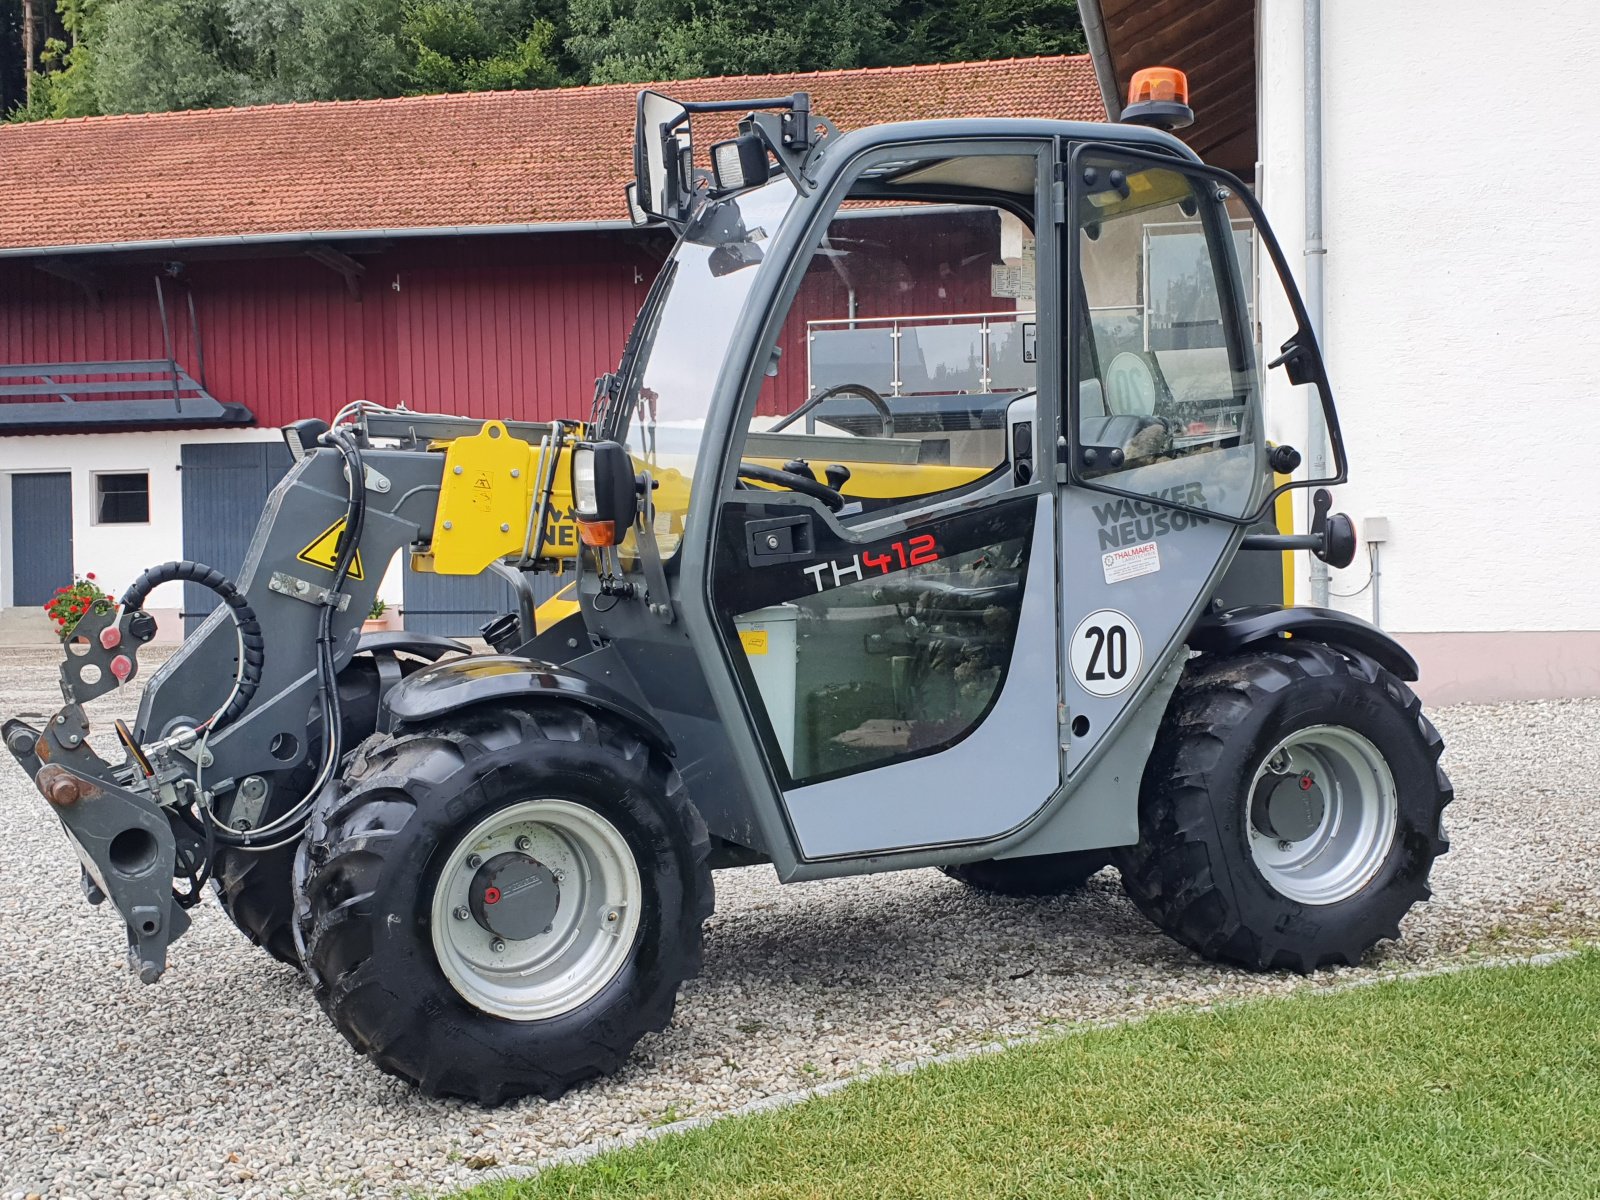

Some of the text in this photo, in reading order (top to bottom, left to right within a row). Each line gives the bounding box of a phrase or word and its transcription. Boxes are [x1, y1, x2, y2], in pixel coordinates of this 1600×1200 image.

[1092, 481, 1207, 526] WACKER
[1098, 503, 1210, 550] NEUSON
[803, 534, 938, 592] TH412
[1113, 544, 1155, 560] THALMAIER
[1085, 625, 1127, 681] 20
